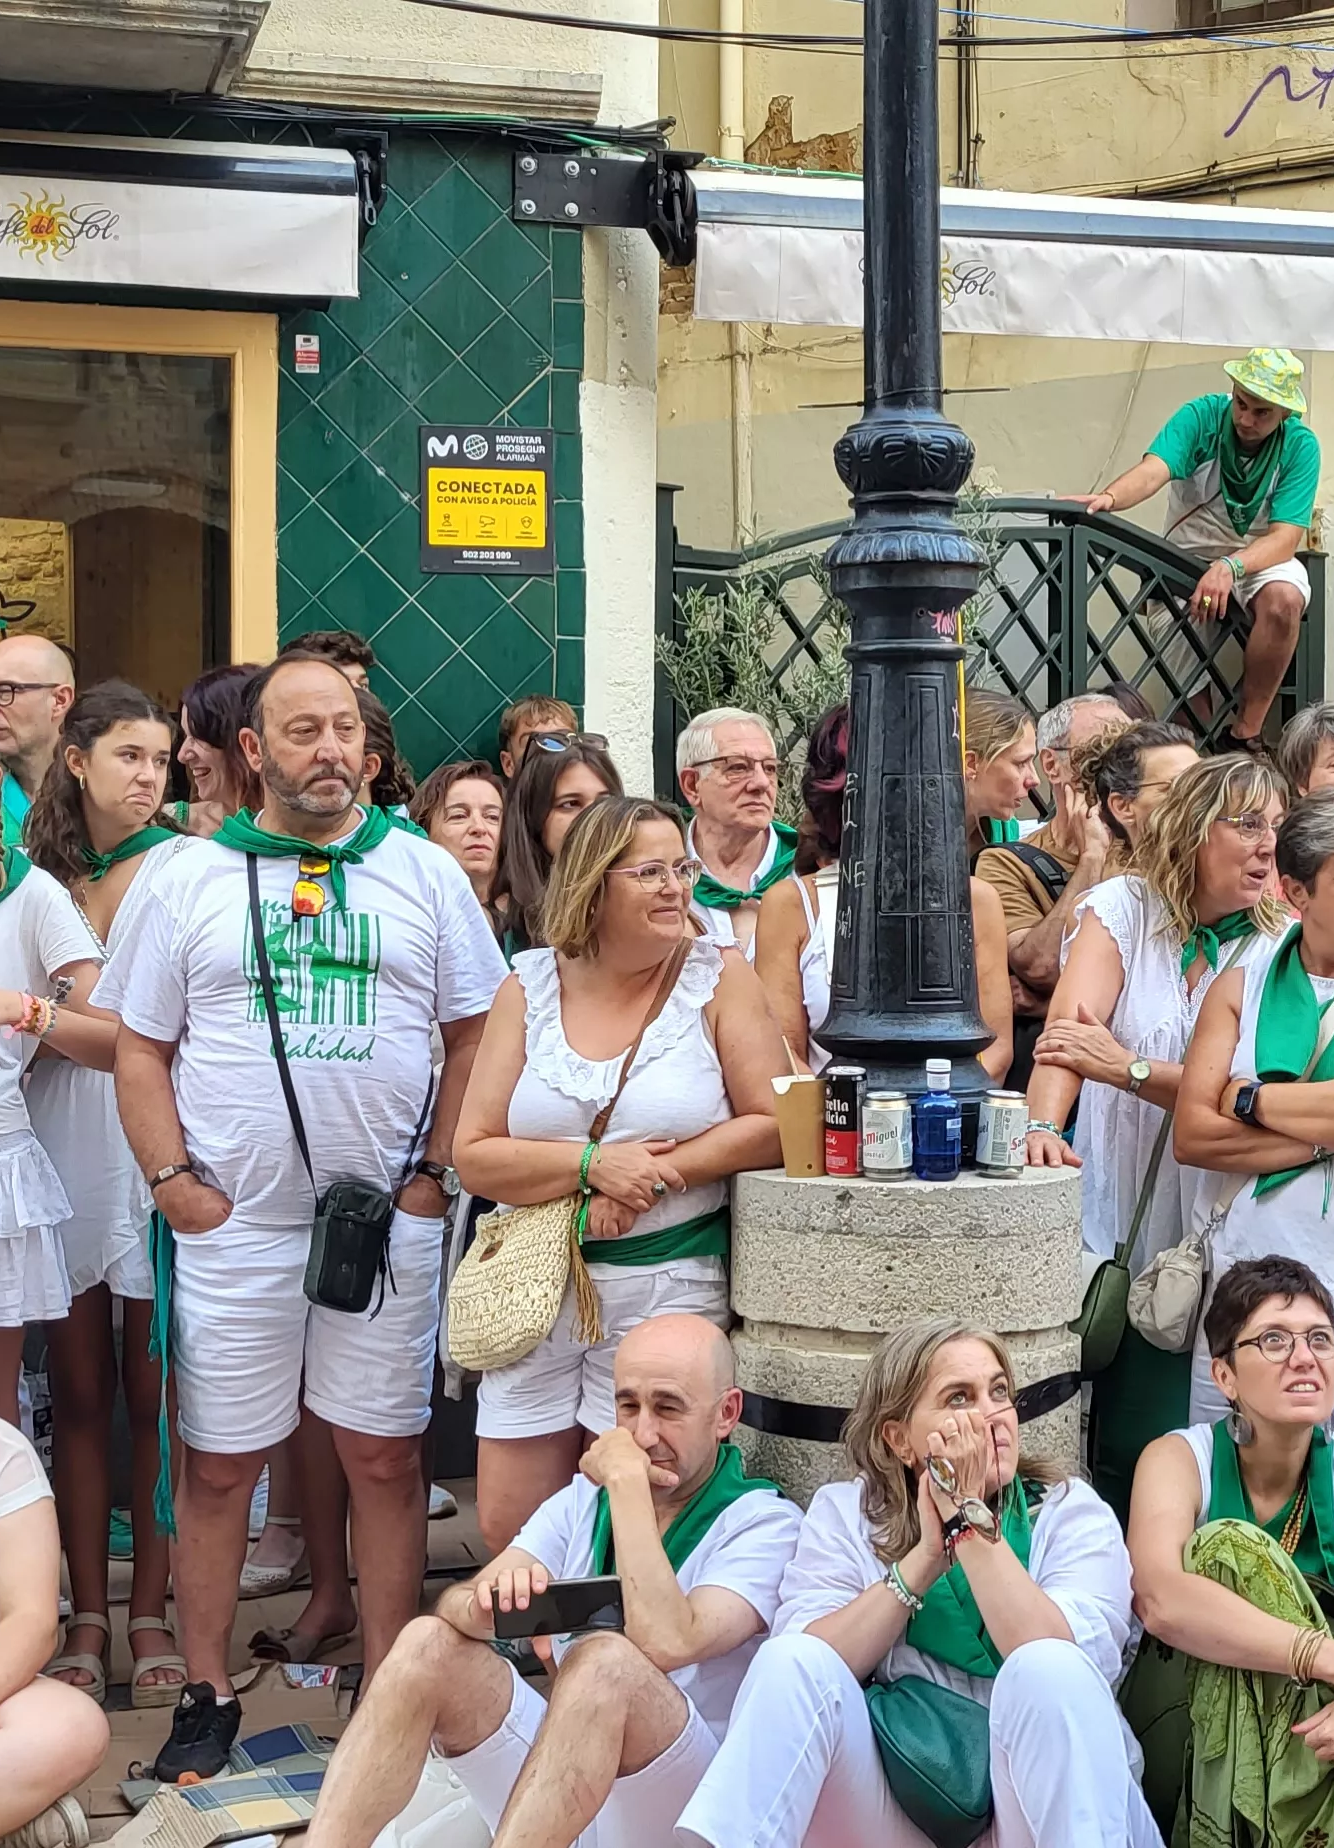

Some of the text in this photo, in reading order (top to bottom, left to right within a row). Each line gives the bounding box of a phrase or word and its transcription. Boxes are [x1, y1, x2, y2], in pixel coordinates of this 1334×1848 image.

[30, 216, 55, 235] del
[58, 203, 120, 256] Sol
[942, 260, 996, 309] Sol
[496, 435, 542, 445] MOVISTAR
[496, 445, 546, 454] PROSEGUR
[496, 453, 535, 462] ALARMAS
[437, 480, 537, 495] CONECTADA
[436, 496, 537, 506] CON AVISO A POLICÍA
